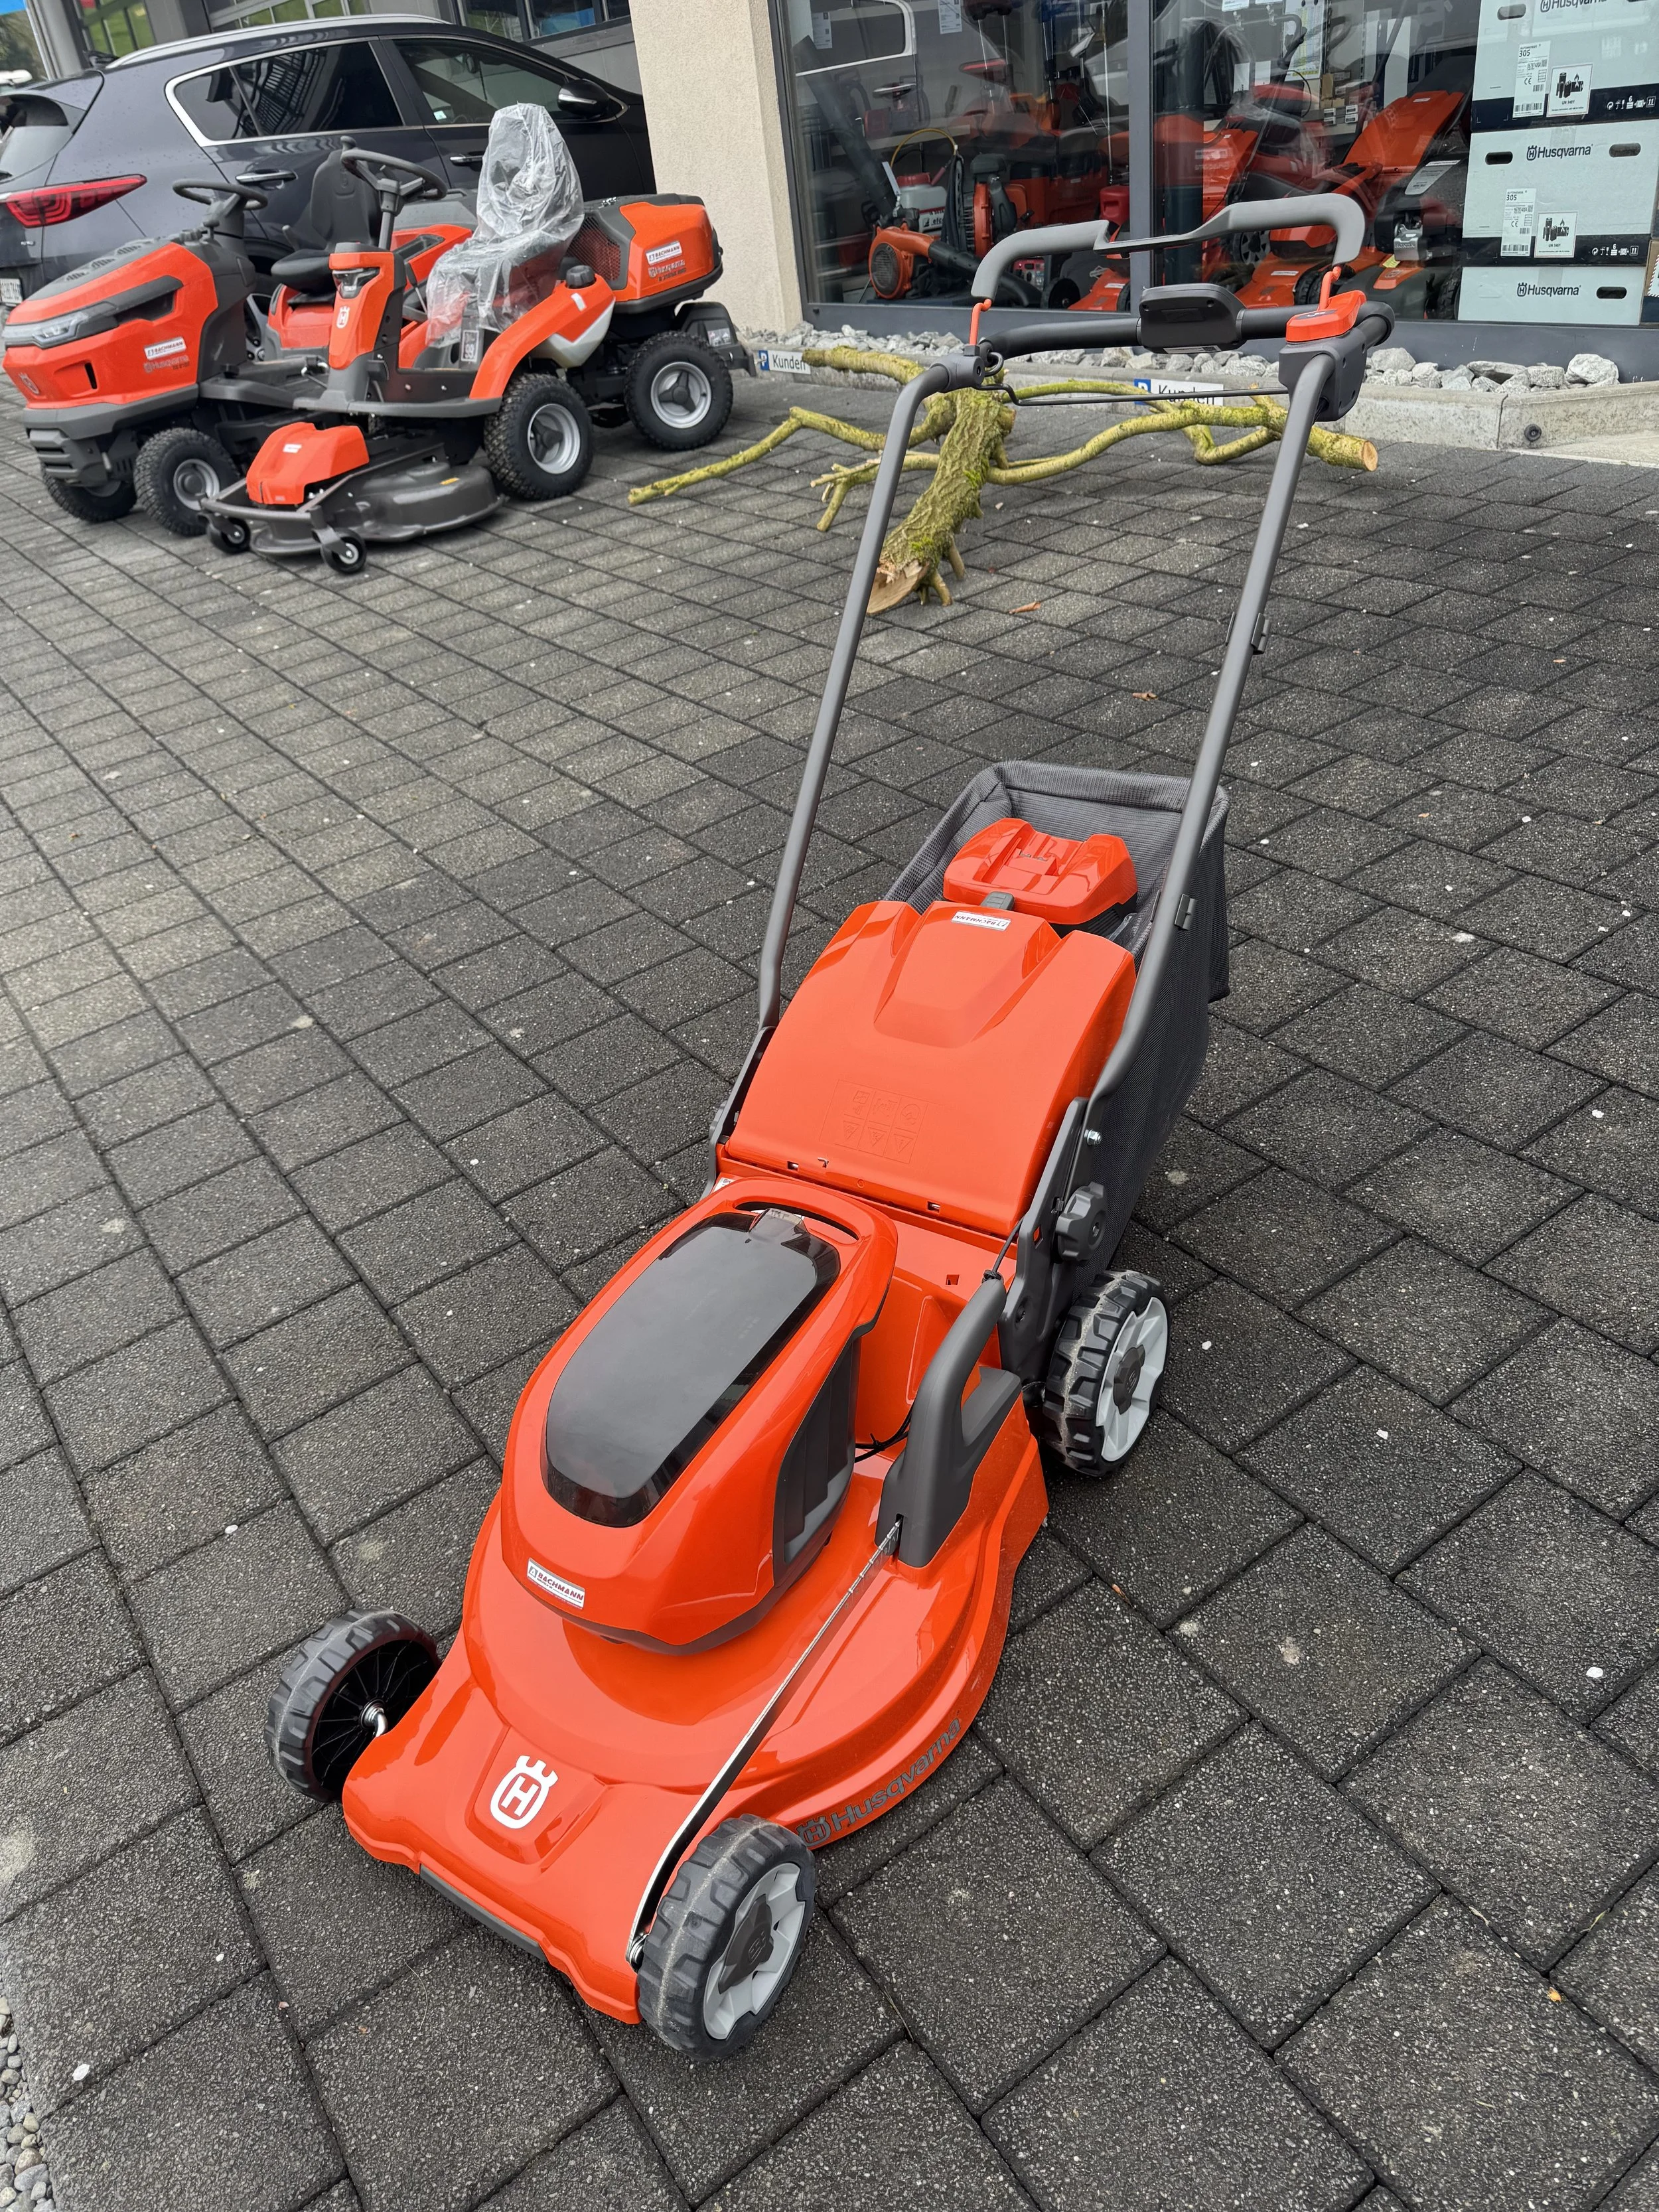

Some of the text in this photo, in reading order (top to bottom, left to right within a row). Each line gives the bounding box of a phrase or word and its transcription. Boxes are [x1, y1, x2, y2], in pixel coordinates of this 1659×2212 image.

[1551, 0, 1607, 9] Husqv
[1537, 146, 1591, 159] Husqvarna
[1528, 285, 1579, 297] Husqvarna
[760, 352, 806, 370] P Kunden
[955, 915, 996, 925] BACHMANN
[538, 1572, 584, 1601] BACHMANN
[831, 1718, 961, 1832] Husqvarna
